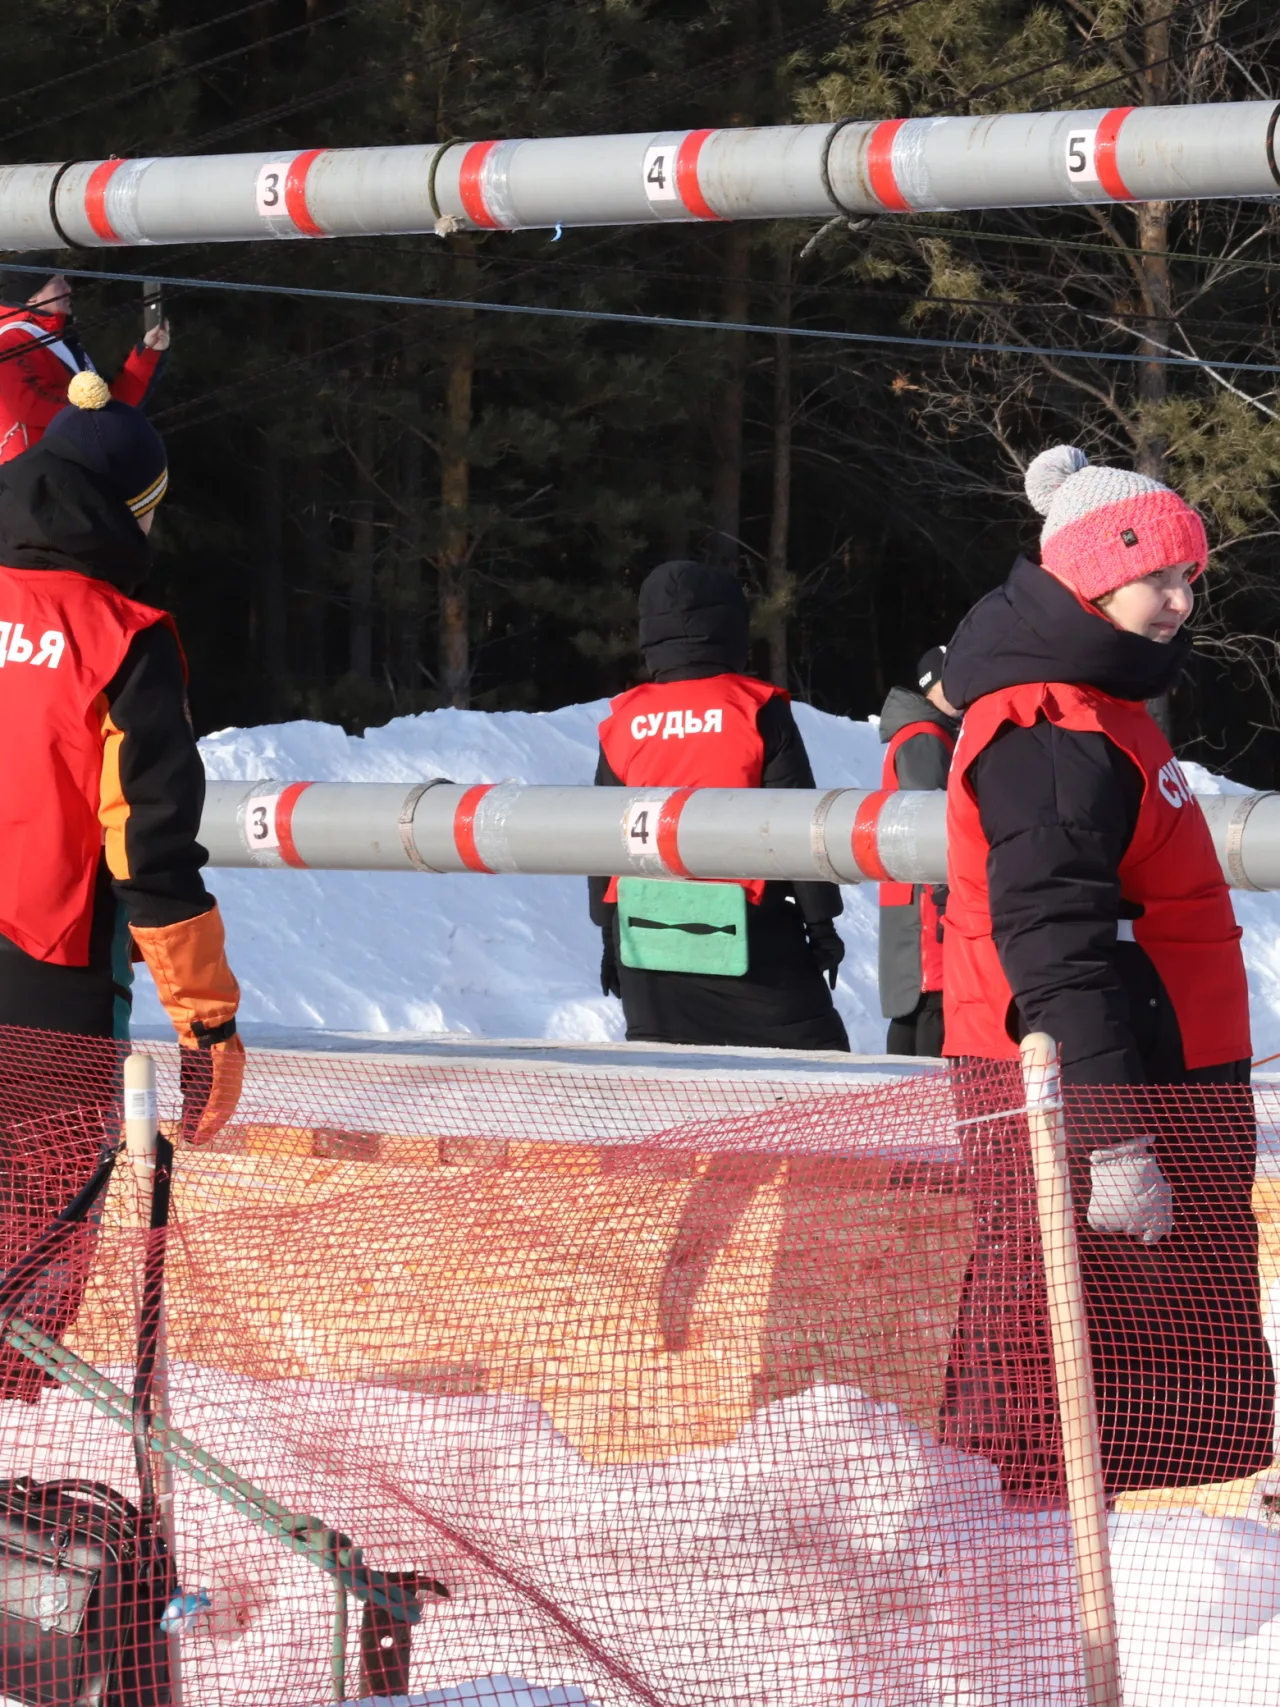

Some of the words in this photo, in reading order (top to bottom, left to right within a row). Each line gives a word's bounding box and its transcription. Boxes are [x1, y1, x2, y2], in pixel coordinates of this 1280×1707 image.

[1069, 137, 1087, 173] 5
[647, 155, 666, 190] 4
[263, 173, 280, 207] 3
[630, 708, 723, 740] СУДЬЯ
[252, 806, 269, 840] 3
[630, 810, 650, 845] 4
